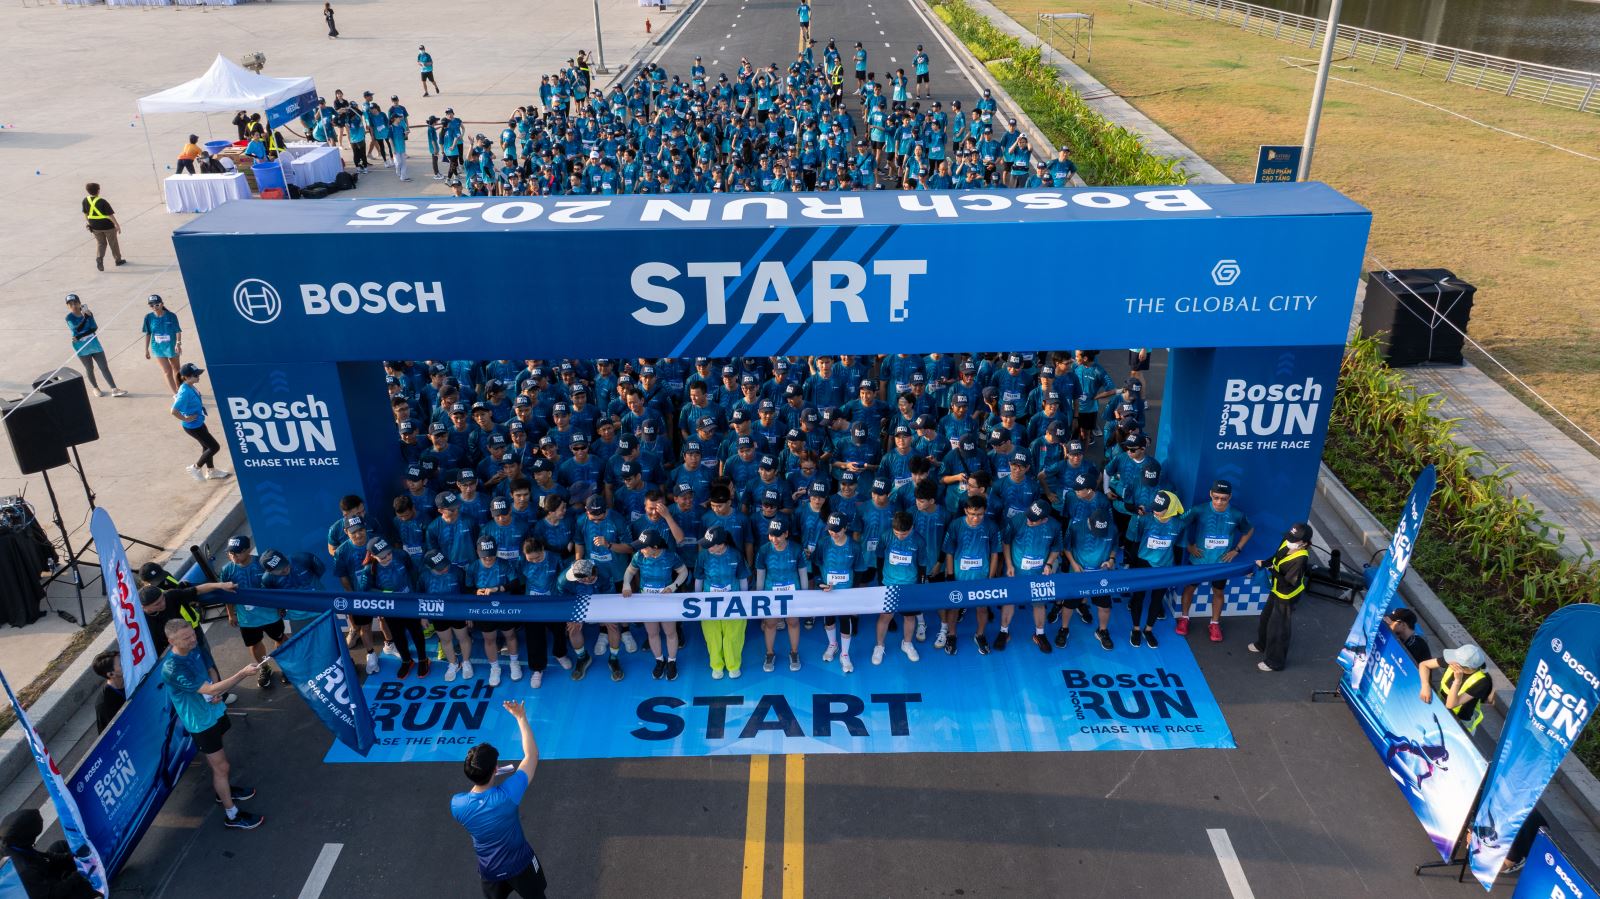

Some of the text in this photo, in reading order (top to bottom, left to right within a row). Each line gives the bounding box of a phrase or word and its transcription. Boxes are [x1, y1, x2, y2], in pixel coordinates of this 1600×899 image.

[346, 189, 1213, 226] Bosch RUN 2025
[299, 281, 446, 315] BOSCH
[630, 259, 928, 326] START
[1125, 295, 1318, 314] THE GLOBAL CITY
[1224, 377, 1322, 402] Bosch
[227, 394, 329, 420] Bosch
[1219, 404, 1230, 436] 2025
[1229, 403, 1319, 436] RUN
[234, 421, 248, 454] 2025
[242, 420, 336, 453] RUN
[1216, 440, 1311, 450] CHASE THE RACE
[244, 457, 340, 468] CHASE THE RACE
[968, 589, 1008, 600] BOSCH
[1030, 580, 1055, 588] Bosch
[1031, 588, 1056, 597] RUN
[353, 599, 395, 610] BOSCH
[419, 602, 445, 612] RUN
[682, 594, 794, 619] START
[1061, 667, 1184, 689] Bosch
[1561, 651, 1600, 690] BOSCH
[307, 679, 329, 704] CHASE
[328, 702, 342, 717] THE
[374, 679, 494, 701] Bosch
[1535, 658, 1588, 721] Bosch
[374, 701, 490, 731] RUN
[629, 692, 923, 741] START
[1069, 690, 1086, 721] 2025
[1078, 690, 1198, 720] RUN
[406, 737, 433, 745] THE
[437, 736, 477, 745] RACE
[1080, 724, 1206, 734] CHASE THE RACE
[84, 757, 103, 783] BOSCH
[94, 750, 129, 797] Bosch
[103, 758, 136, 806] RUN
[1555, 865, 1584, 899] BOSCH
